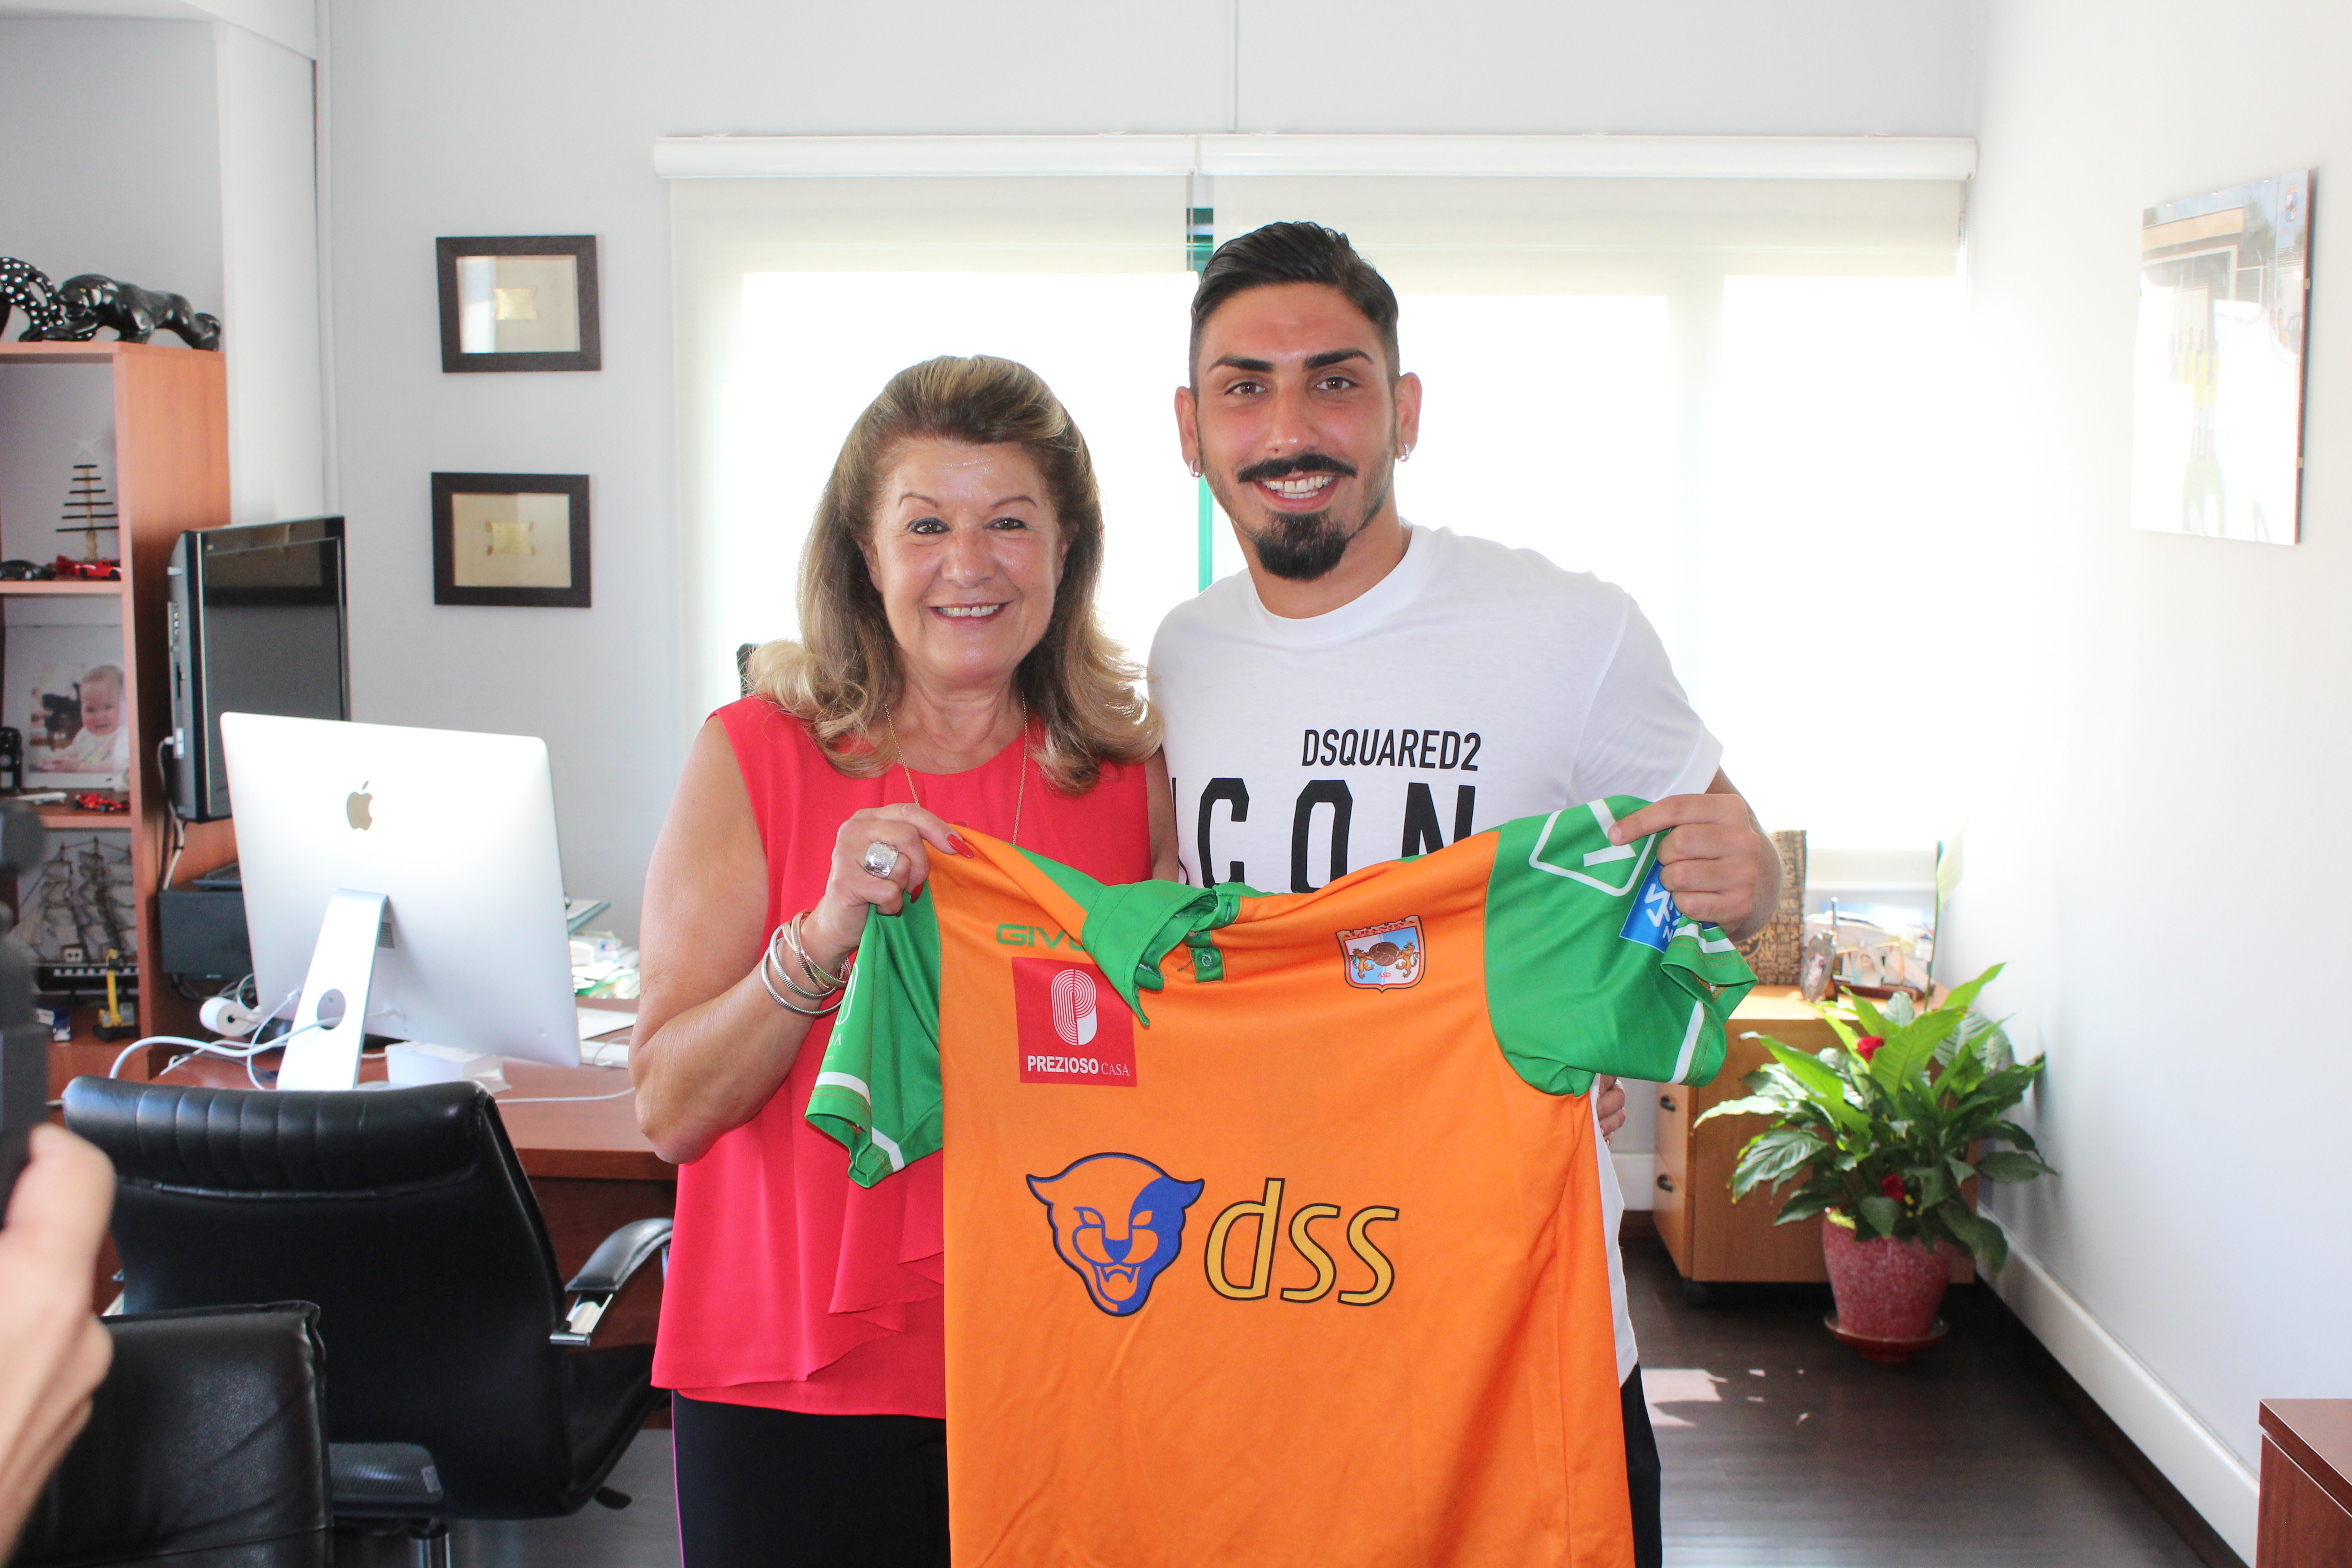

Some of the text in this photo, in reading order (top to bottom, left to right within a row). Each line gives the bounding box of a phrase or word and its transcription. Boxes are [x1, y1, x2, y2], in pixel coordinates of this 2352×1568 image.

[1302, 729, 1481, 771] DSQUARED2
[1172, 778, 1475, 893] CON
[1027, 1055, 1130, 1076] PREZIOSO CASA
[1204, 1177, 1400, 1306] dss
